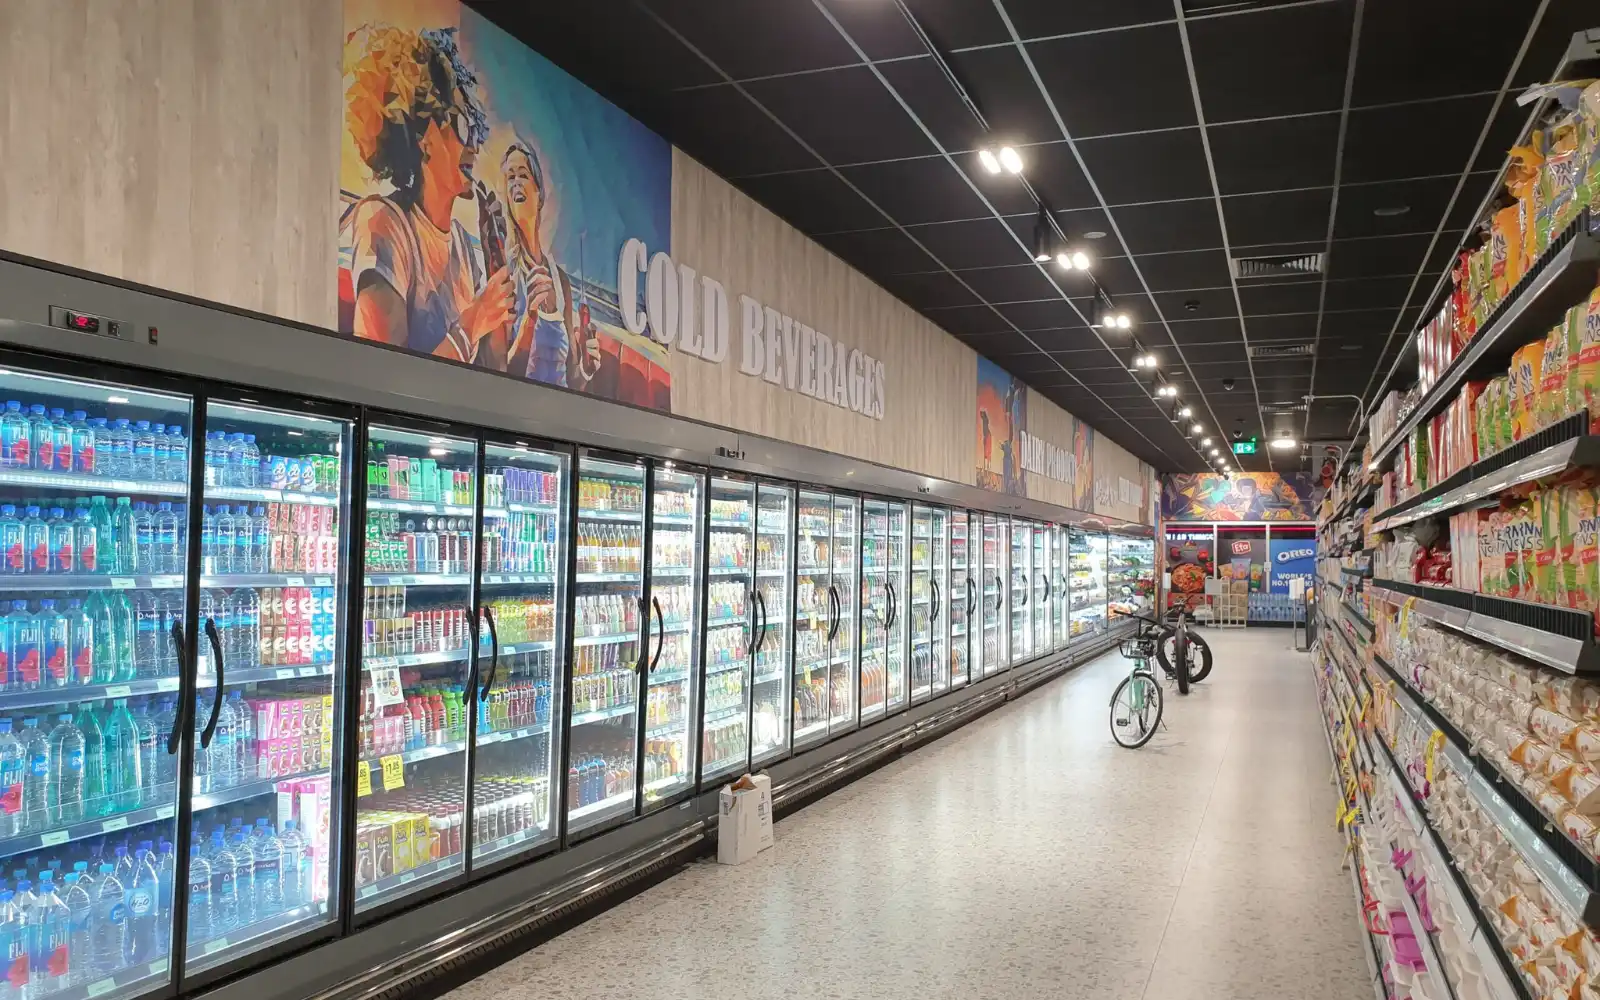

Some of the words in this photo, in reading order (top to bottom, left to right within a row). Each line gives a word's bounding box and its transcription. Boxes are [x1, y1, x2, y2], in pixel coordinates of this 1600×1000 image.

[617, 237, 729, 364] COLD
[738, 294, 885, 421] BEVERAGES
[1277, 549, 1314, 561] OREO
